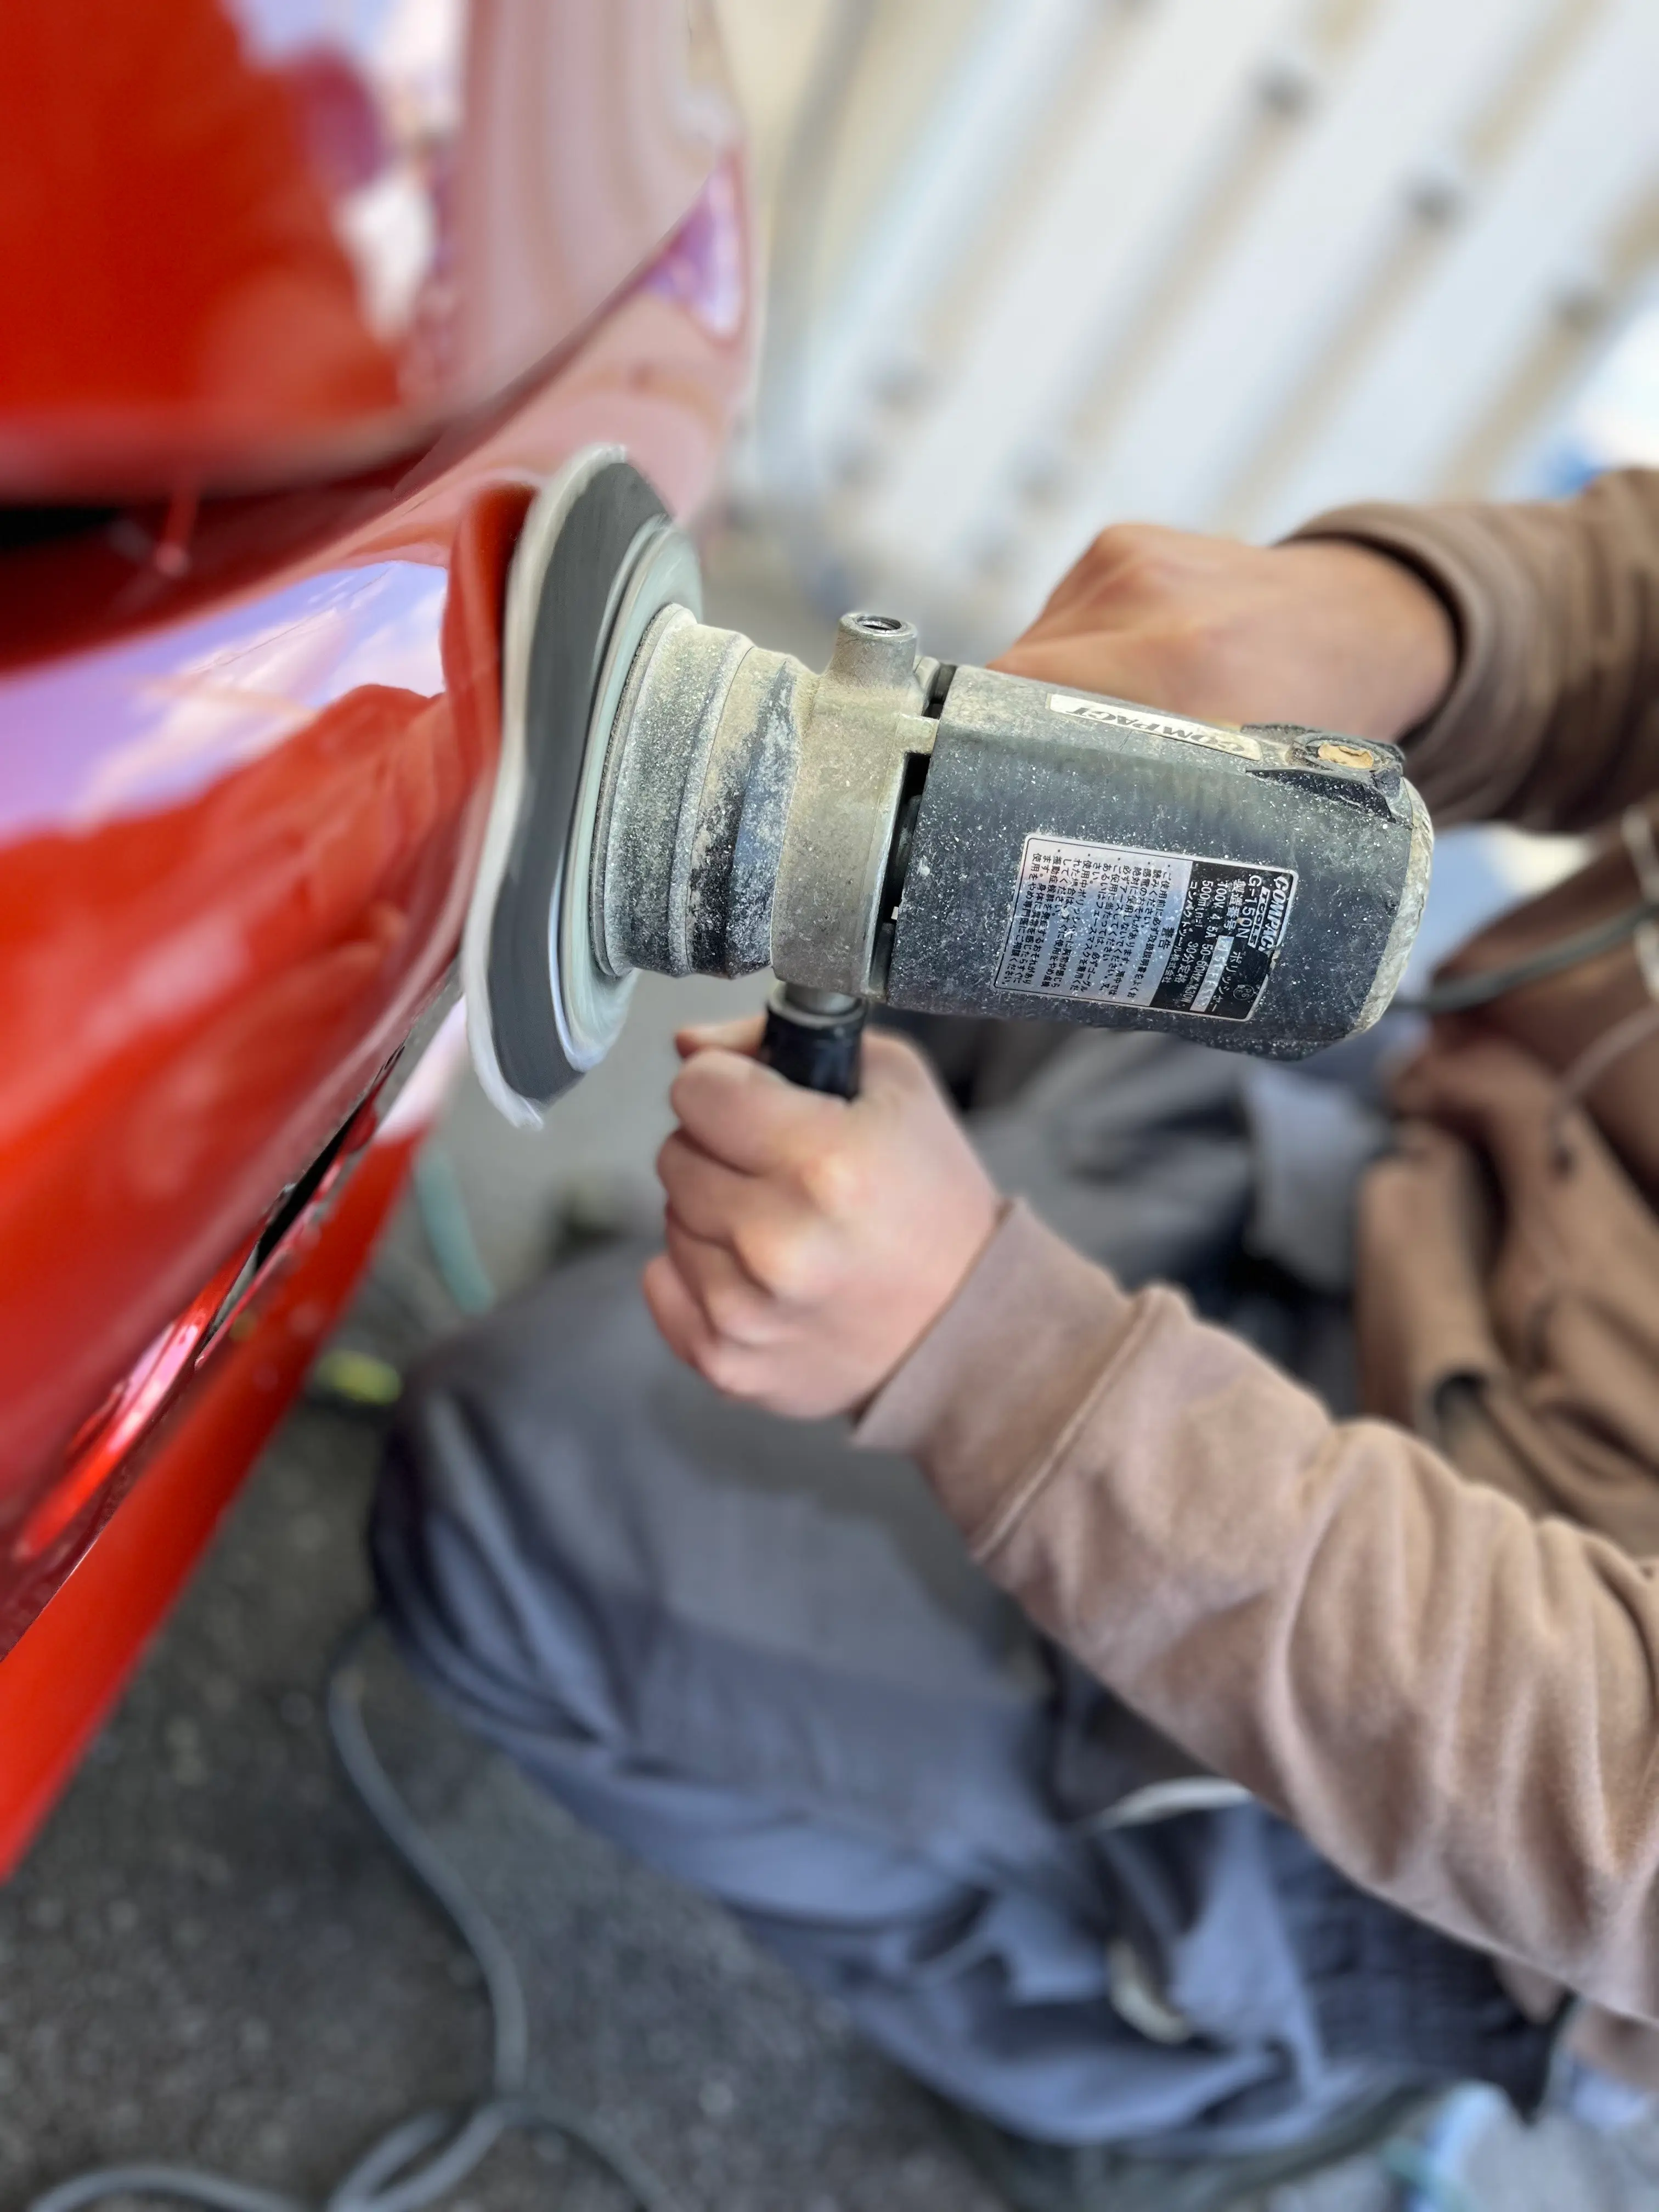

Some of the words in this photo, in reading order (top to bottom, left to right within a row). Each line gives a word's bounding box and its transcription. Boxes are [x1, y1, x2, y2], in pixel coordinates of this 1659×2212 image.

[1066, 707, 1245, 752] COMPACT
[1051, 859, 1071, 916] してください。
[1089, 862, 1102, 884] さい。
[1141, 869, 1162, 928] 読みください。
[1212, 883, 1228, 909] 100V
[1222, 878, 1246, 930] 製造番号
[1235, 875, 1261, 938] G-150N
[1249, 892, 1268, 945] TOOLS
[1157, 927, 1175, 950] 警告
[1161, 881, 1198, 983] コンパクトツール株式会社
[1173, 941, 1199, 984] 30分定格
[1189, 944, 1213, 981] 50-60Hz
[1211, 951, 1243, 1012] ポリッシャー
